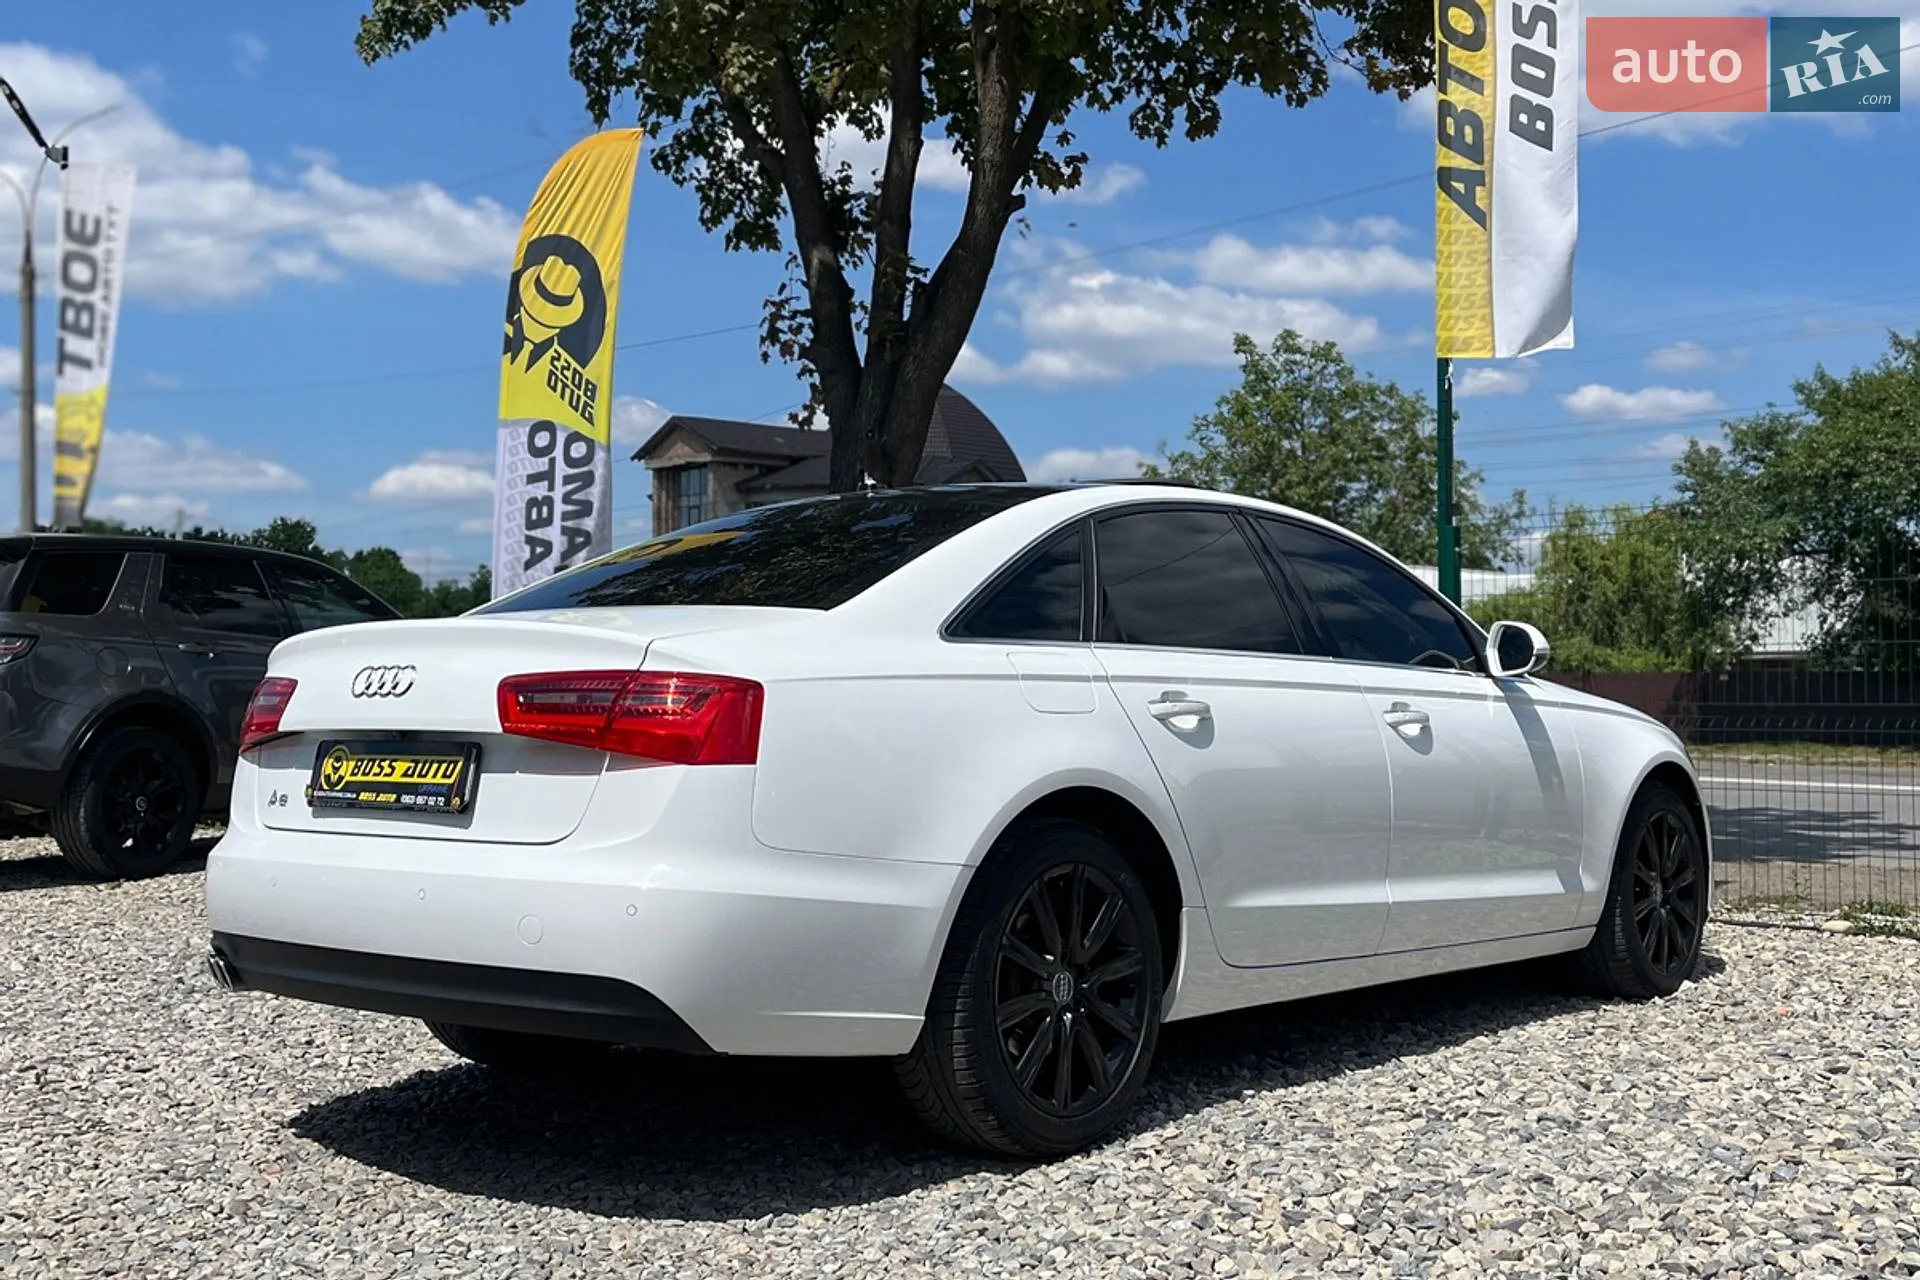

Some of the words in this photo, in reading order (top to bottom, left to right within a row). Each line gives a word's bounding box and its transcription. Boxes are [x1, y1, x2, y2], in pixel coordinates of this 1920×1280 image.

[1509, 0, 1557, 151] BOS
[351, 760, 396, 776] BOSS
[402, 760, 458, 778] AUTO
[267, 789, 288, 807] A6
